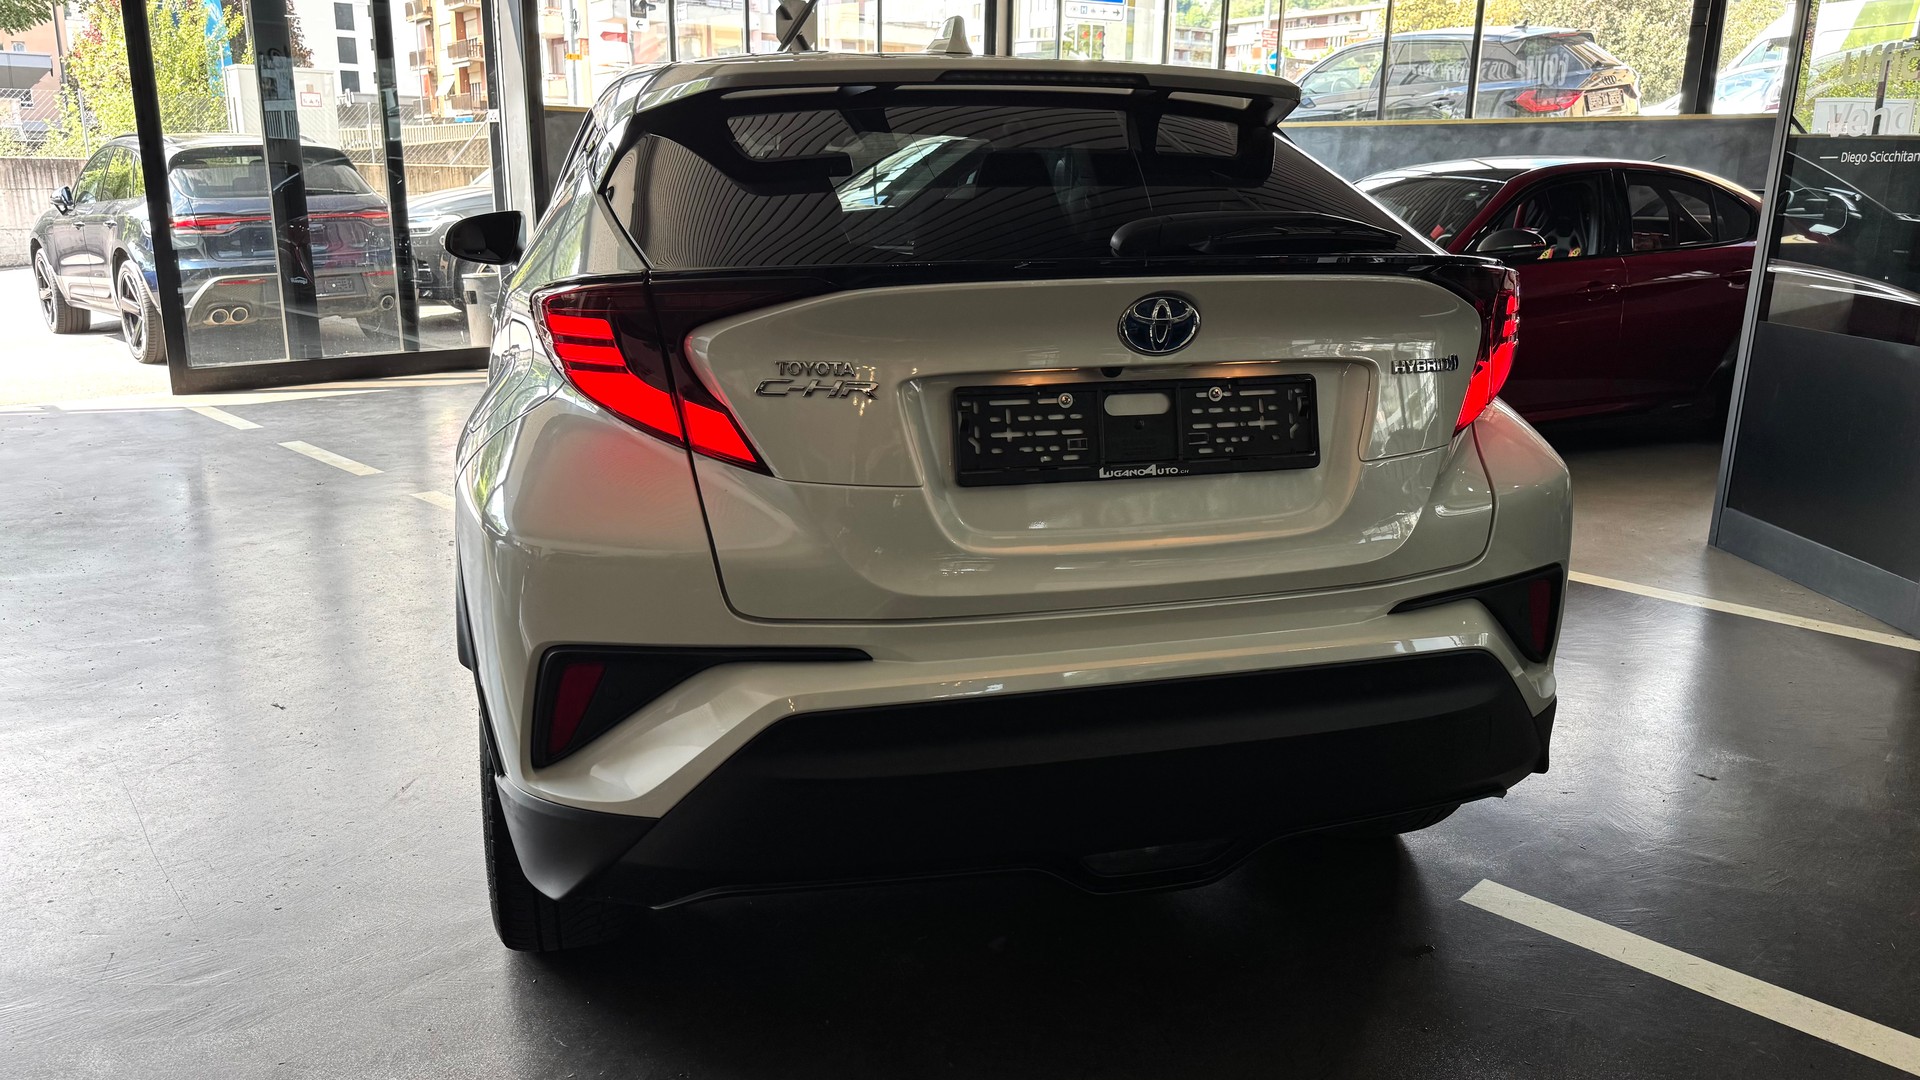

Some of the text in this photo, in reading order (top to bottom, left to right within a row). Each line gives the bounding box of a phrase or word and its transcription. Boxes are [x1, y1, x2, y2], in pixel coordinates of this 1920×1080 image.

[1840, 151, 1868, 166] Diego
[774, 360, 857, 376] TOYOTA
[1391, 354, 1459, 375] HYBRID
[754, 378, 880, 400] C-HR
